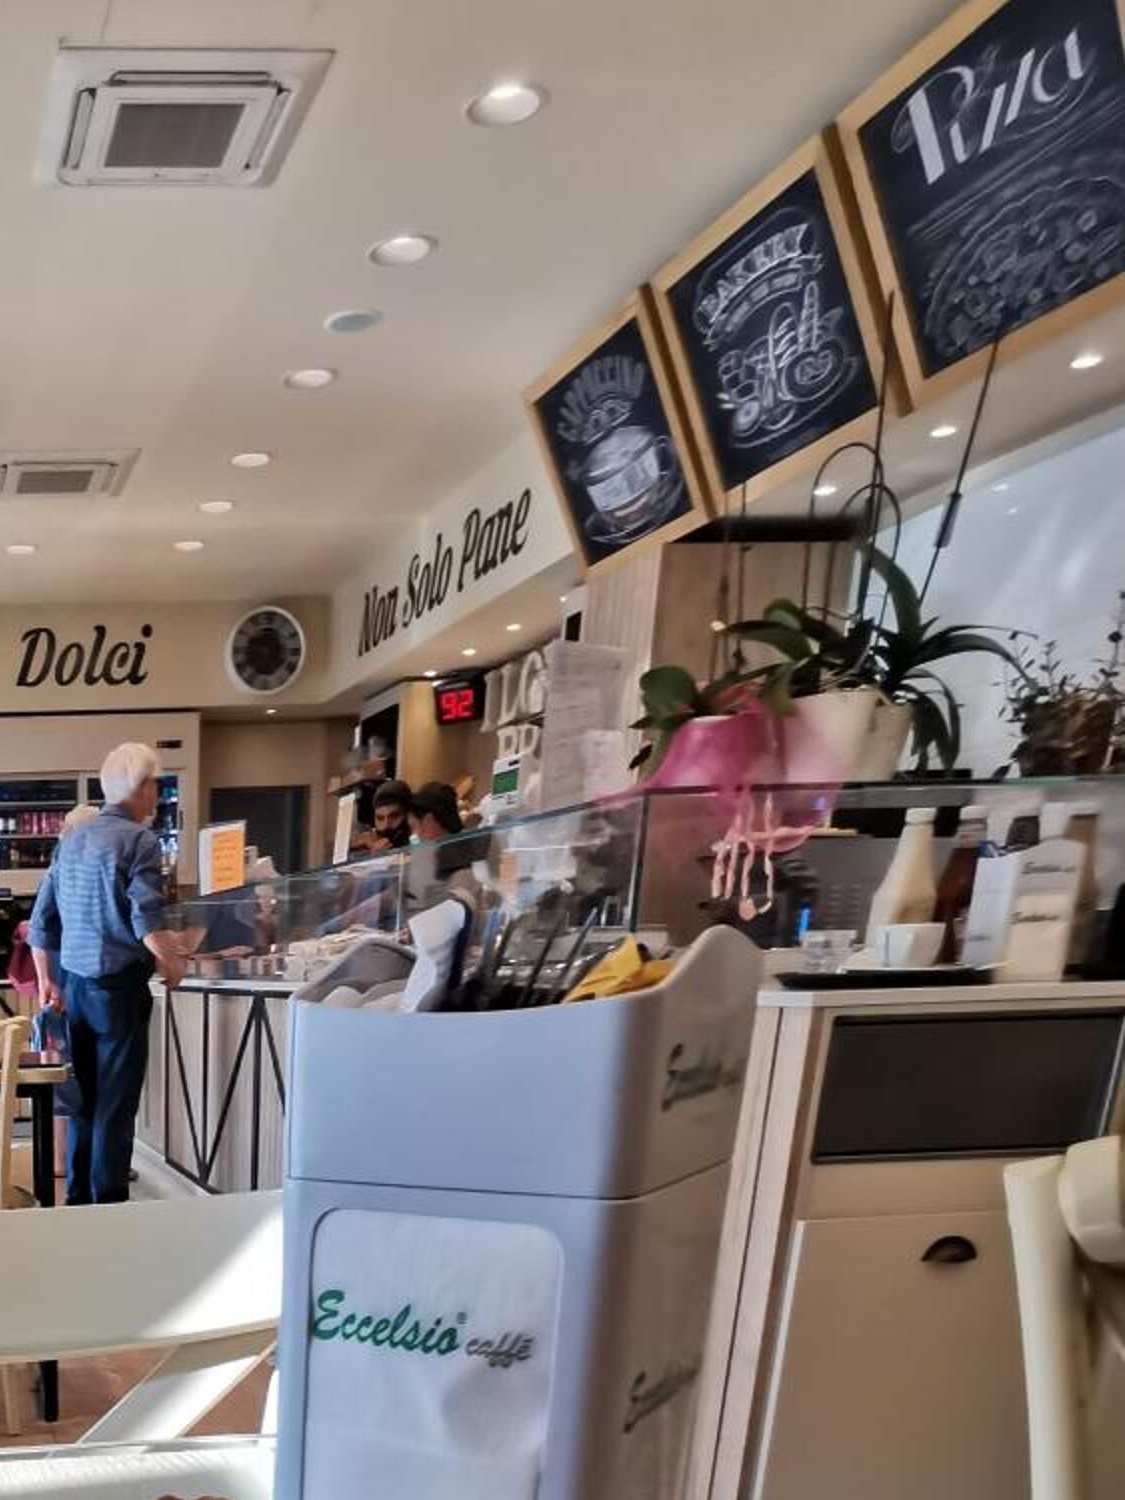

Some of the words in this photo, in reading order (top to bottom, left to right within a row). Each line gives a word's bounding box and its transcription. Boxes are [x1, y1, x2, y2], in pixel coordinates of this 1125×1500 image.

[358, 586, 398, 657] Non
[402, 533, 454, 628] Solo
[457, 488, 532, 593] Pane
[16, 623, 153, 687] Dolci
[441, 688, 474, 721] 92
